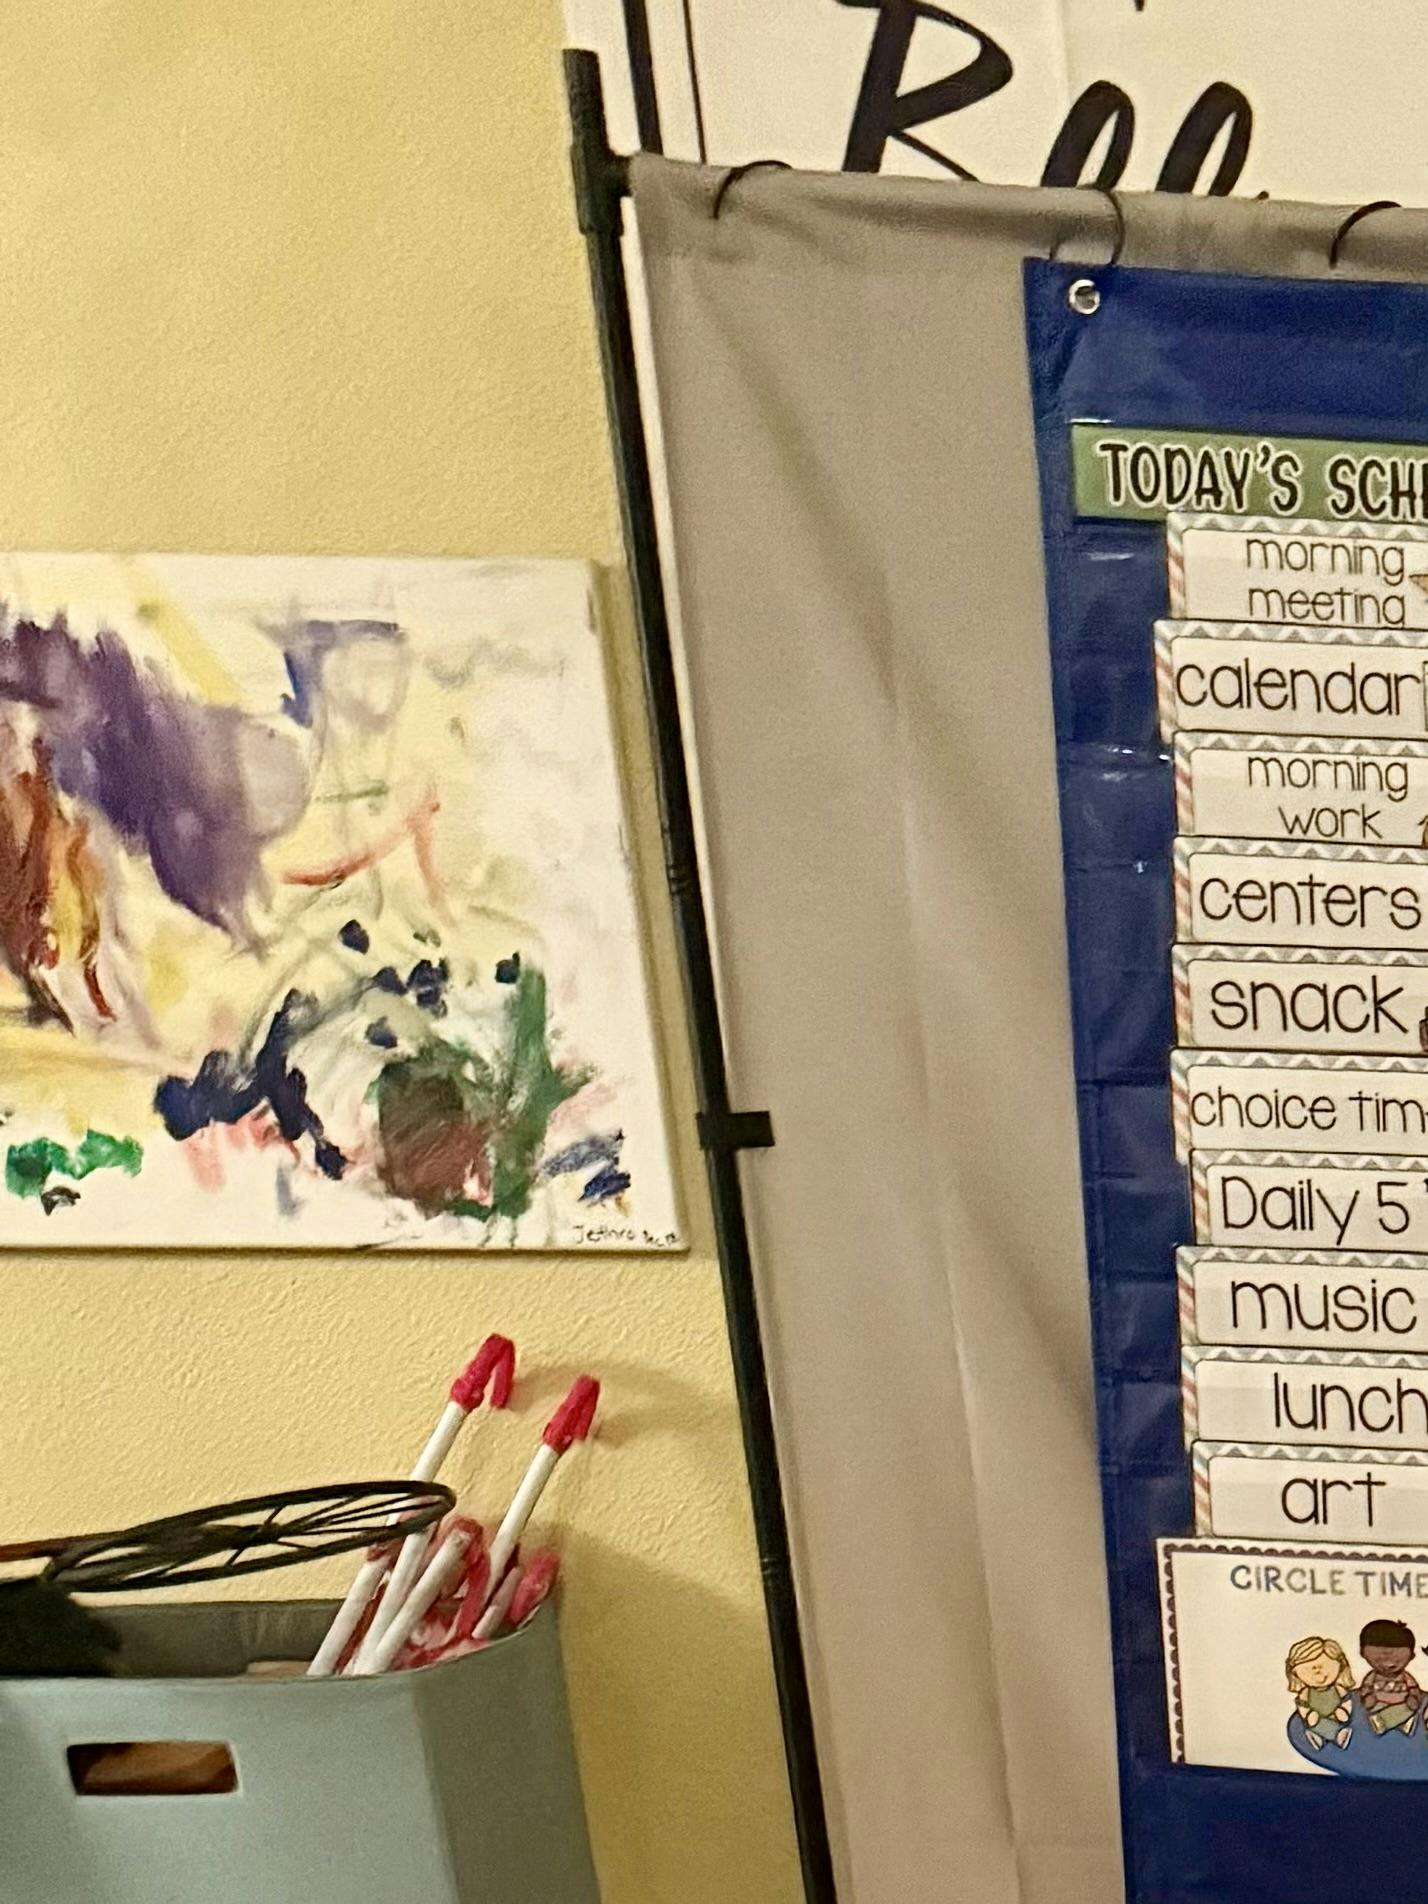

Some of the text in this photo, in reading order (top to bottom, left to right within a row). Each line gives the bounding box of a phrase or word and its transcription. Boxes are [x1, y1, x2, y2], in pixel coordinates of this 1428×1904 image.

[1098, 442, 1302, 516] TODAY'S
[1246, 537, 1406, 583] morning
[1249, 583, 1406, 628] meeting
[1176, 658, 1421, 716] calendar
[1248, 754, 1410, 802] morning
[1278, 803, 1383, 839] work
[1200, 874, 1422, 930] centers
[1210, 976, 1408, 1034] snack
[1191, 1087, 1338, 1132] choice
[1222, 1176, 1410, 1246] Daily 5
[1231, 1278, 1418, 1335] music
[1281, 1471, 1387, 1528] art
[1230, 1564, 1346, 1597] CIRCLE
